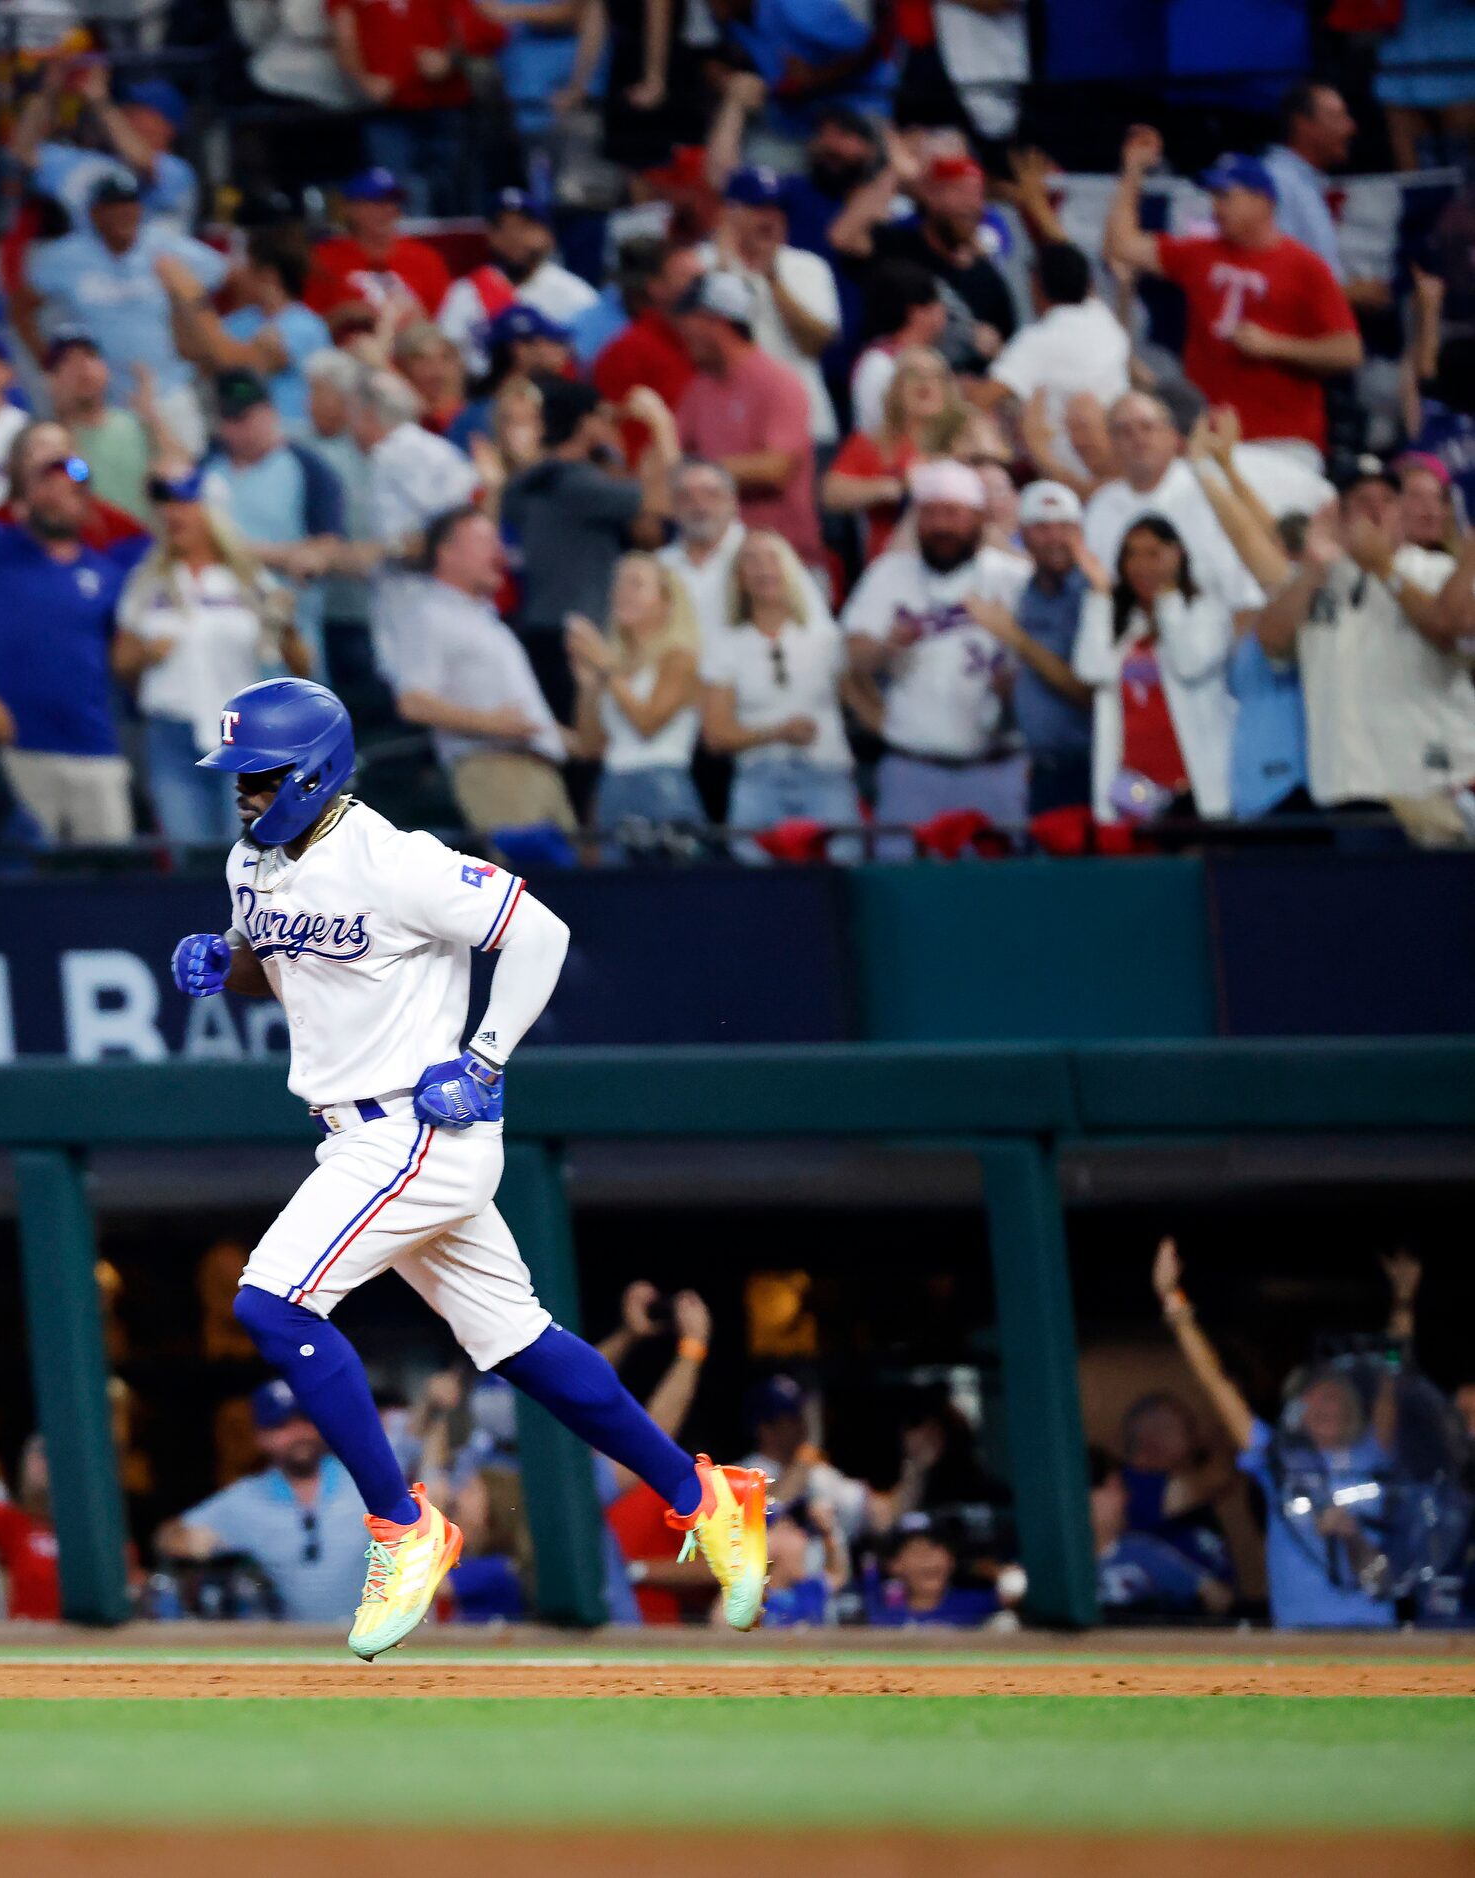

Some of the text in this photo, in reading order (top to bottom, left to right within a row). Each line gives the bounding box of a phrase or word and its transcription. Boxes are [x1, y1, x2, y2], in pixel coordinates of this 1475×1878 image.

[1208, 263, 1268, 339] T
[220, 710, 241, 745] T
[236, 882, 373, 963] Rangers
